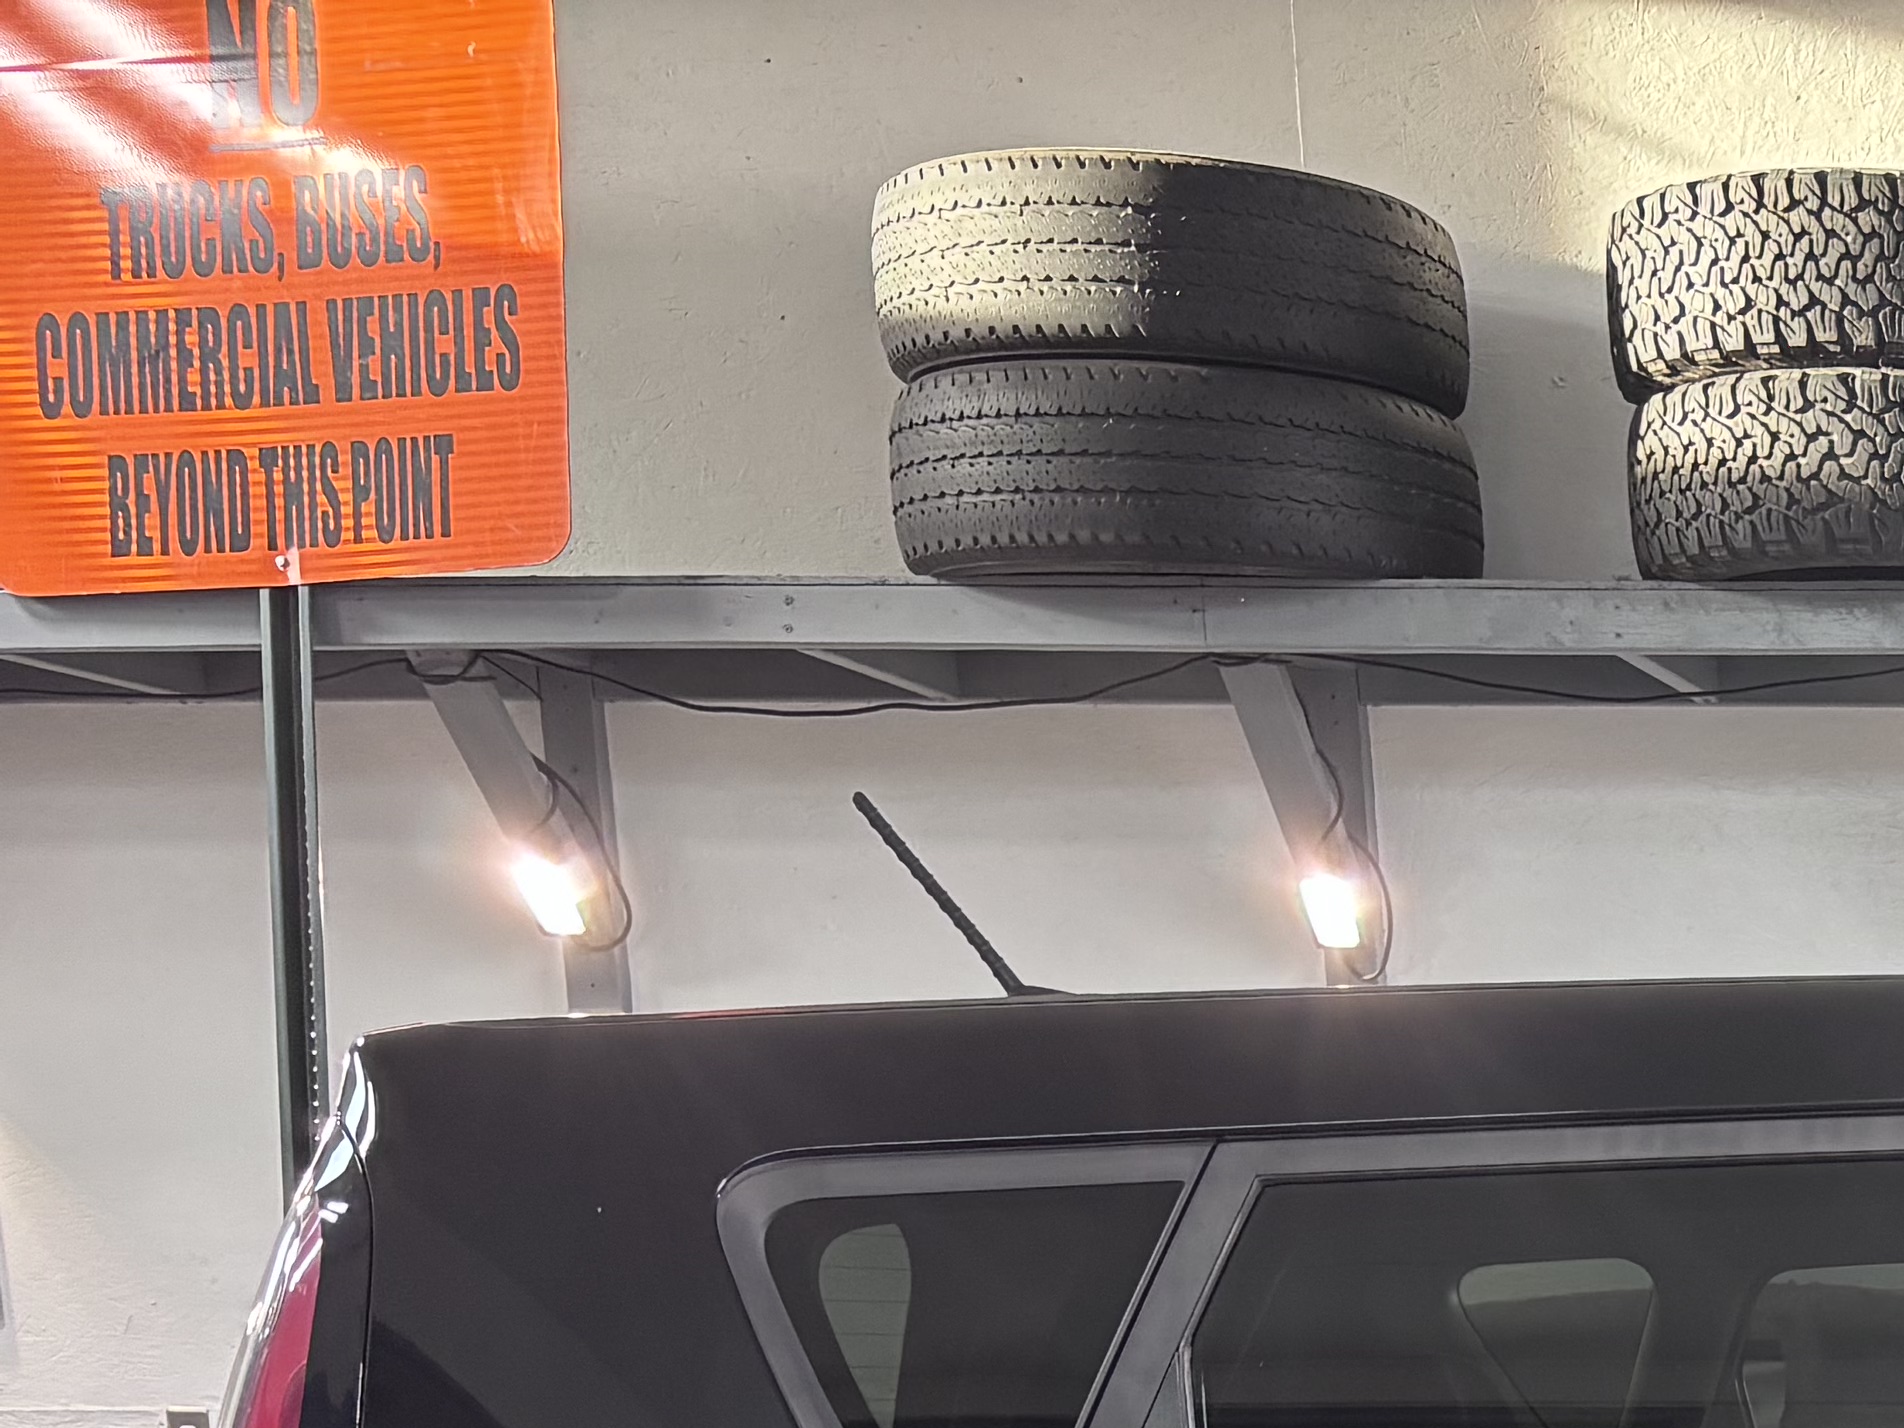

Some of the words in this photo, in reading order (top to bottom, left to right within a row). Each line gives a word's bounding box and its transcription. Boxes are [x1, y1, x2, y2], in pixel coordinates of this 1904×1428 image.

[205, 0, 320, 128] NO
[100, 177, 286, 283] TRUCKS,
[293, 164, 442, 271] BUSES,
[35, 300, 321, 420] COMMERCIAL
[325, 283, 522, 404] VEHICLES
[107, 448, 252, 559] BEYOND
[258, 440, 342, 553] THIS
[350, 432, 455, 545] POINT
